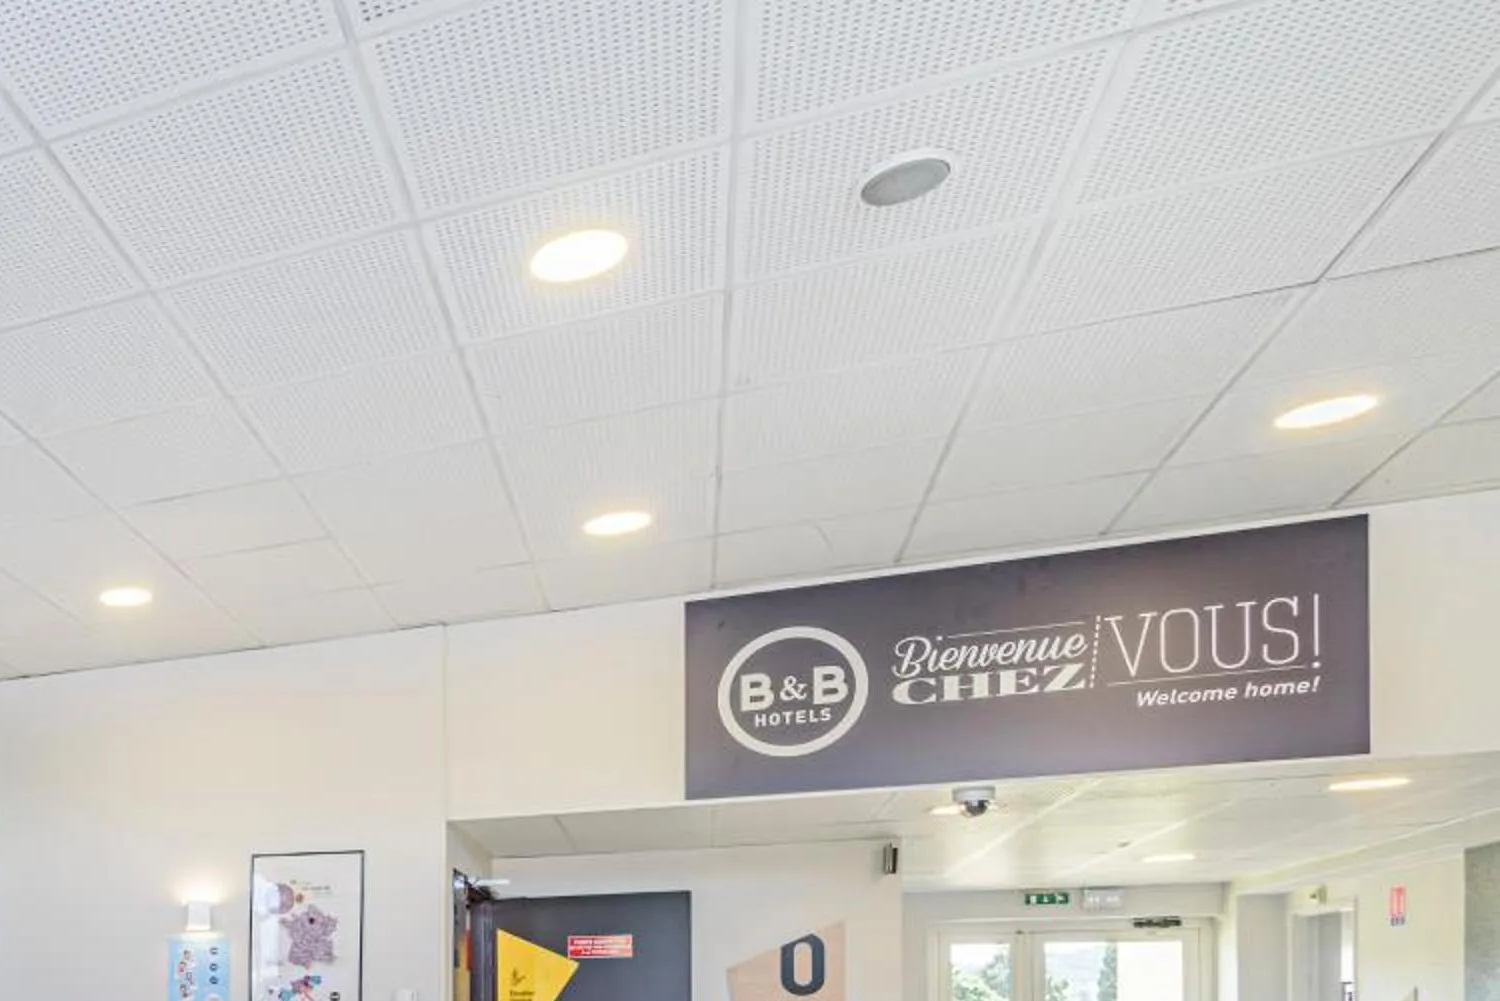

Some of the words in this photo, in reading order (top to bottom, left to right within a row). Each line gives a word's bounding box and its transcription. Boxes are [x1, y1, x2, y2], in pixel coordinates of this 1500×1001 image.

[891, 633, 1088, 679] Bienvenue
[1103, 593, 1322, 678] VOUS!
[891, 663, 1087, 705] CHEZ
[1136, 685, 1238, 708] Welcome
[1244, 675, 1322, 699] home!
[754, 707, 832, 728] HOTELS
